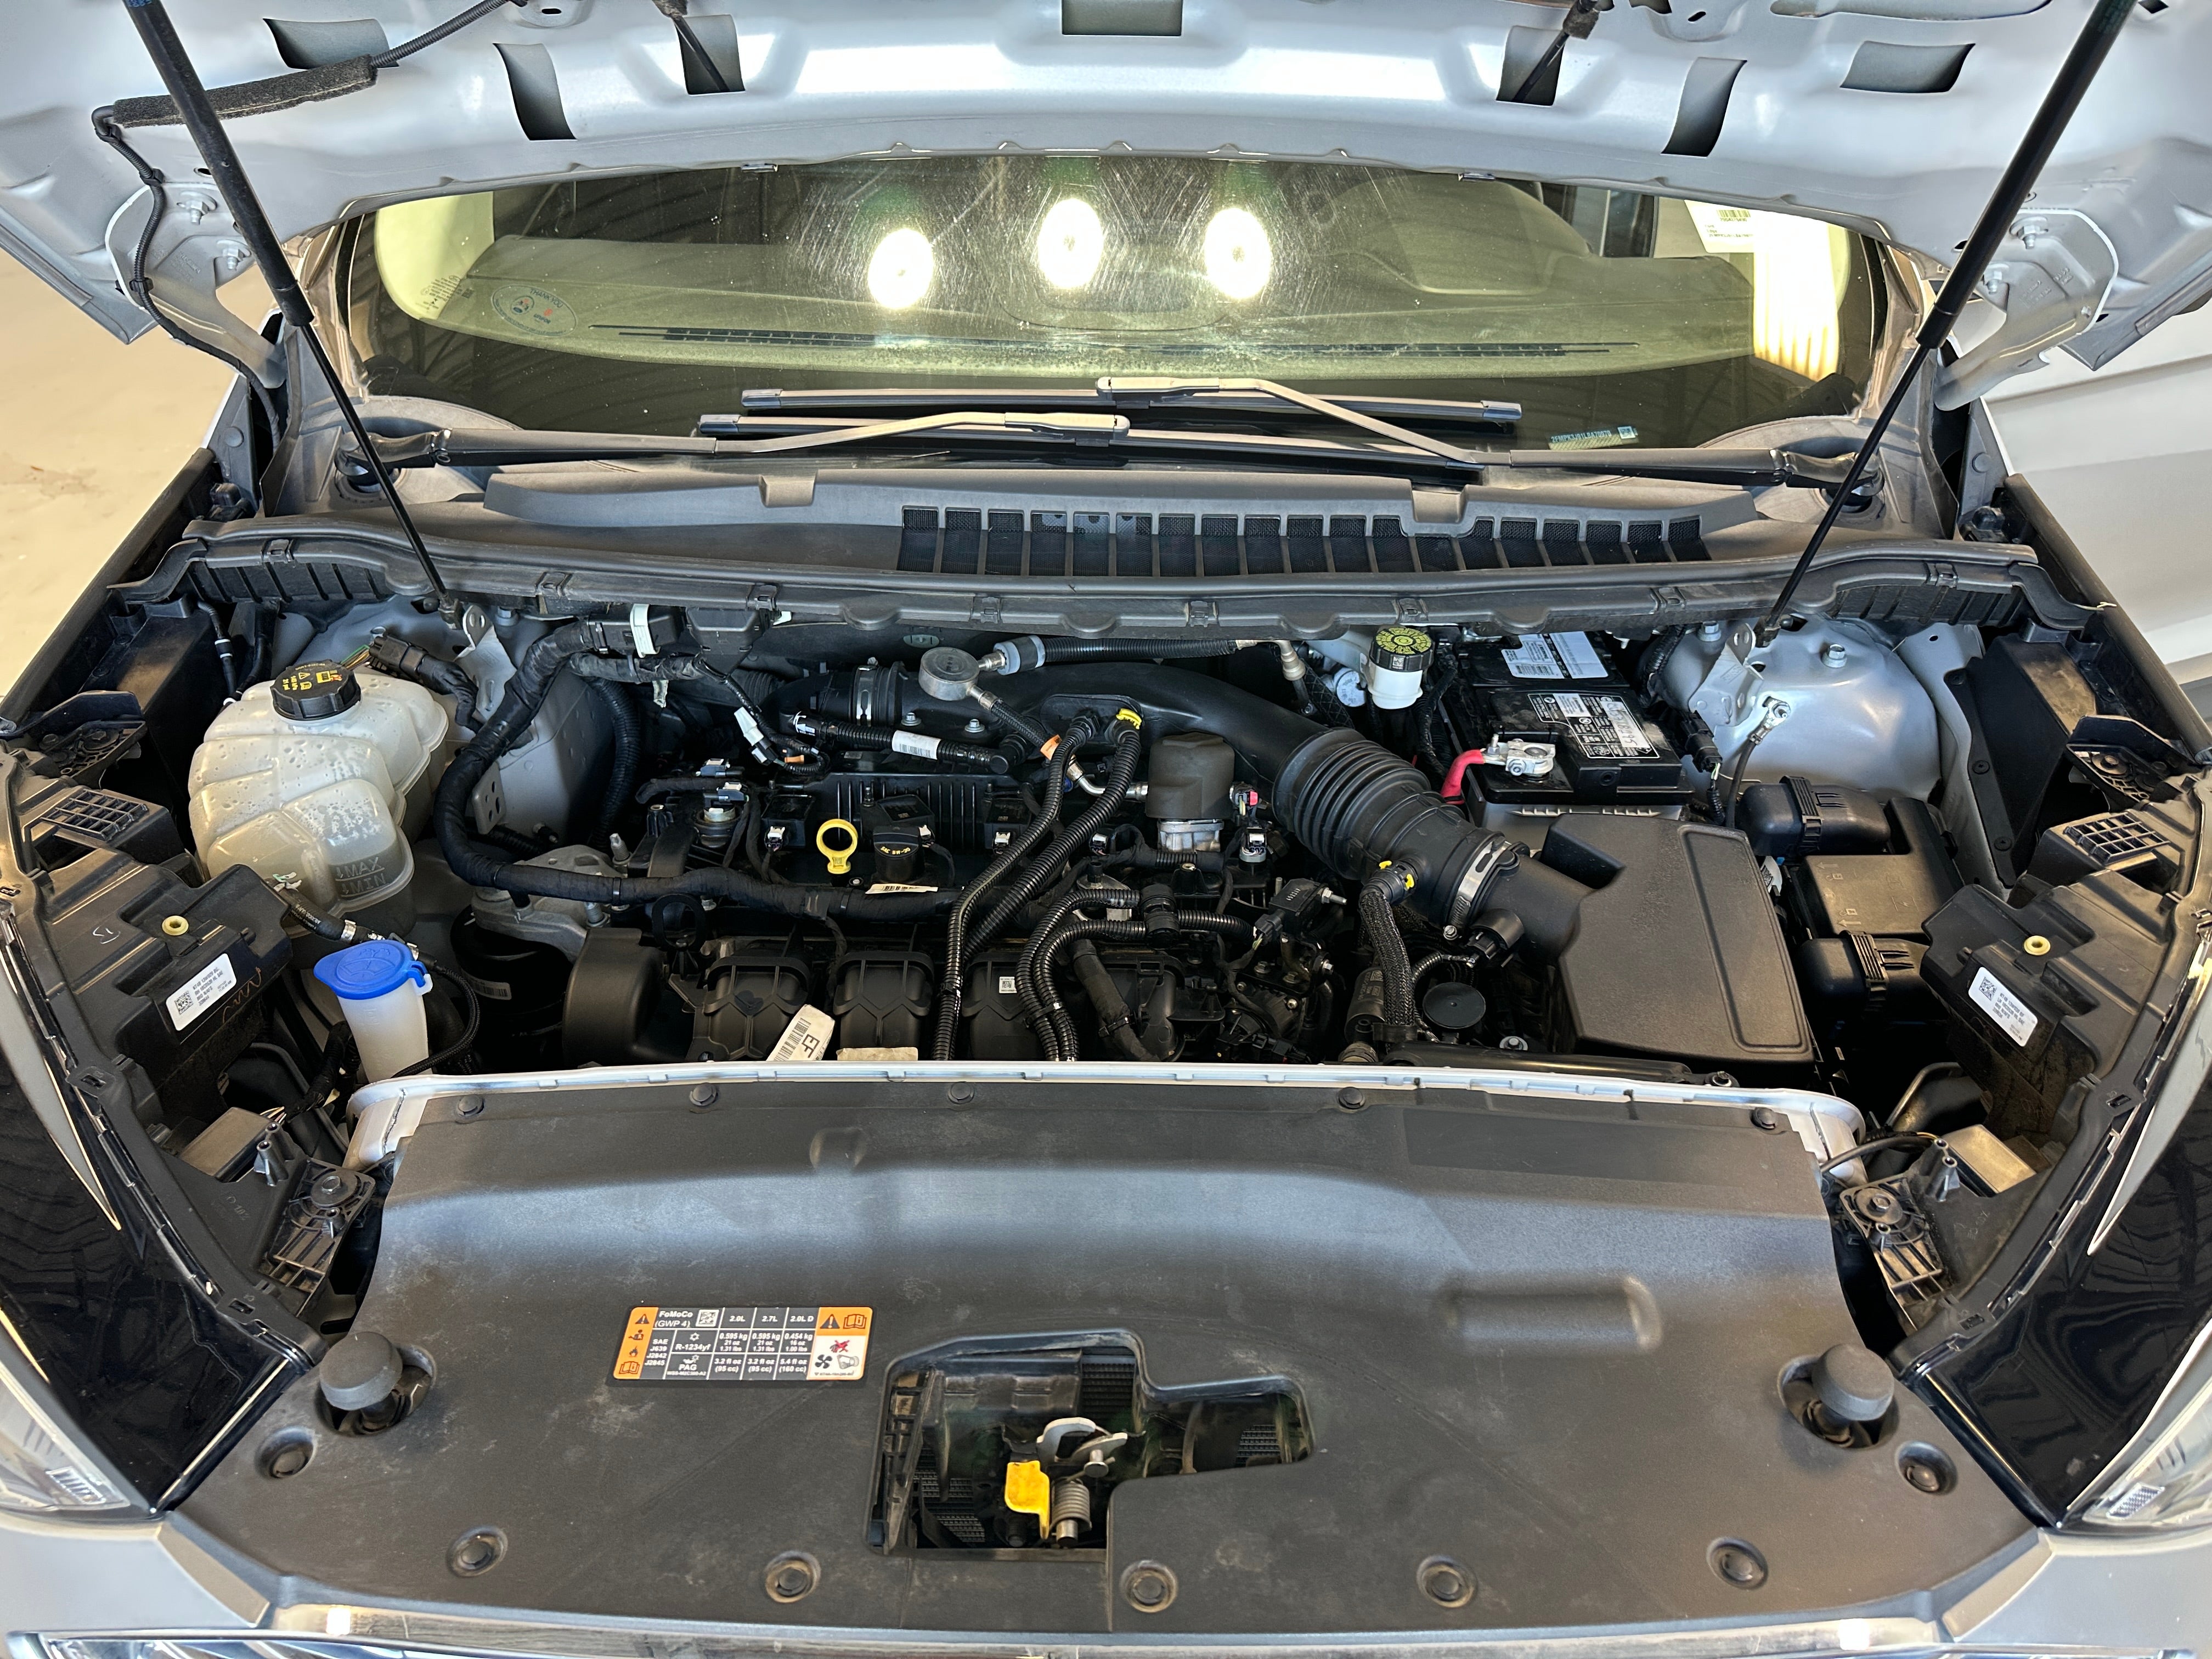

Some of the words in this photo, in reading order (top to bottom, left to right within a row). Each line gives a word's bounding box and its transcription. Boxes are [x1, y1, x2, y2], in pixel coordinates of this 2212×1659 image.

[530, 289, 551, 300] THANK
[551, 297, 564, 308] YOU
[345, 857, 382, 878] MAX
[350, 873, 386, 893] MIN
[802, 1034, 820, 1058] EF
[675, 1344, 711, 1352] R-1234yf
